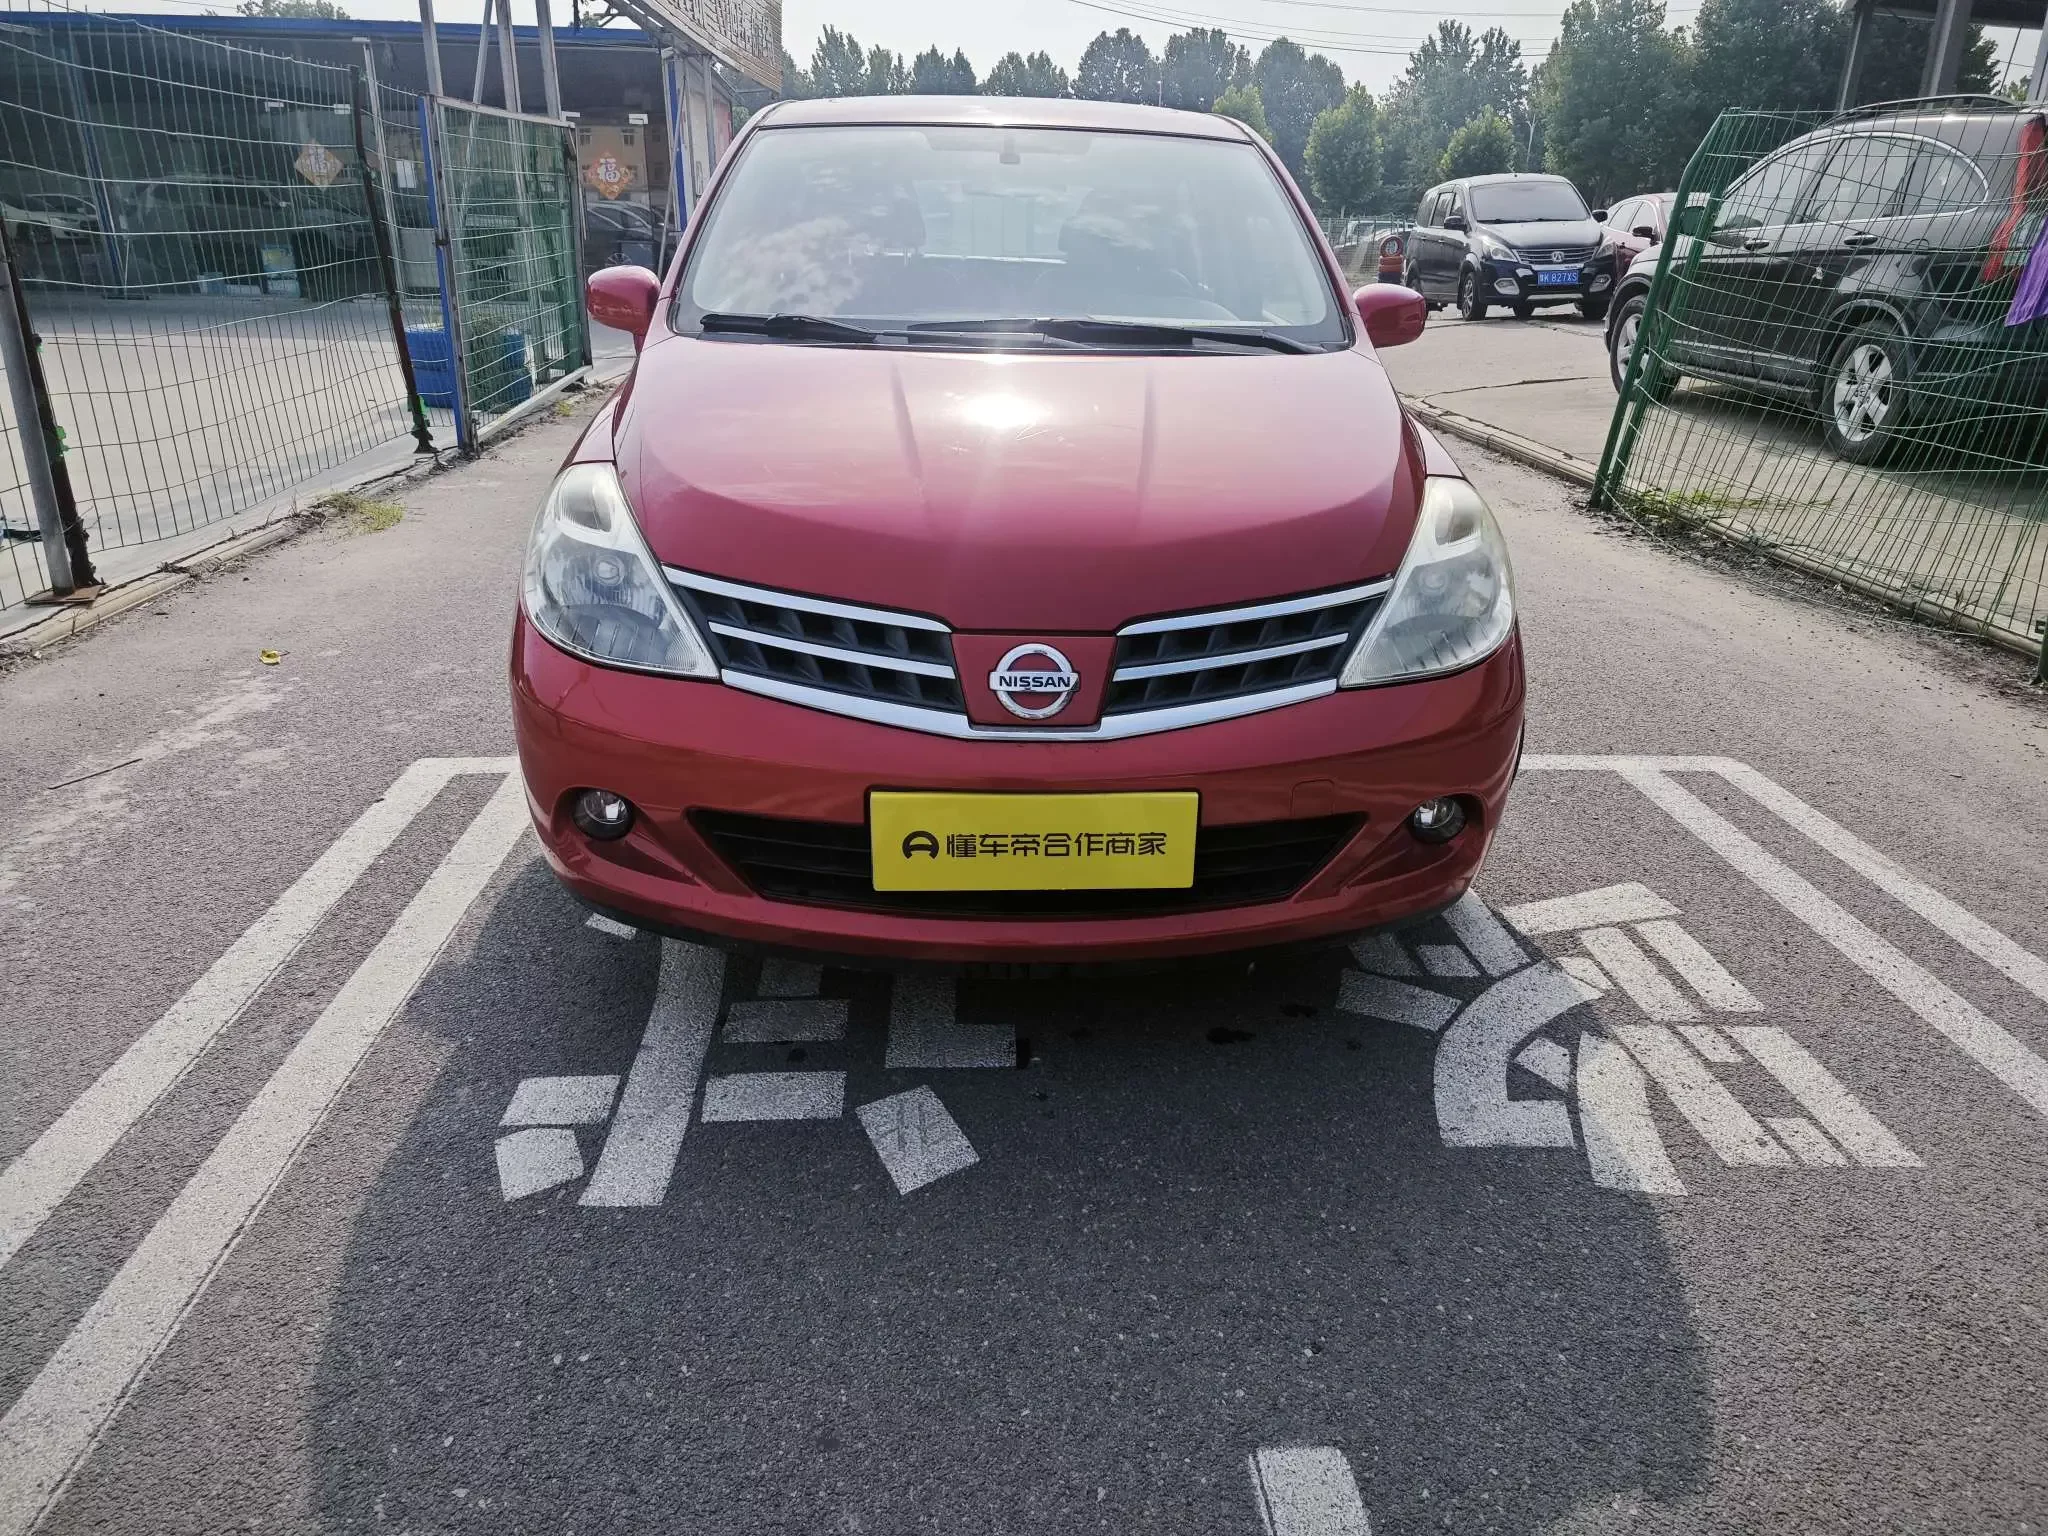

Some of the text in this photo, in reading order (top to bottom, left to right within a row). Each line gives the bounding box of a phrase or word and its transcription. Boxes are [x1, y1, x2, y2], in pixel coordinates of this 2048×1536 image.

[597, 158, 620, 182] 福
[999, 675, 1071, 689] NISSAN
[946, 832, 1167, 858] 懂车帝合作商家
